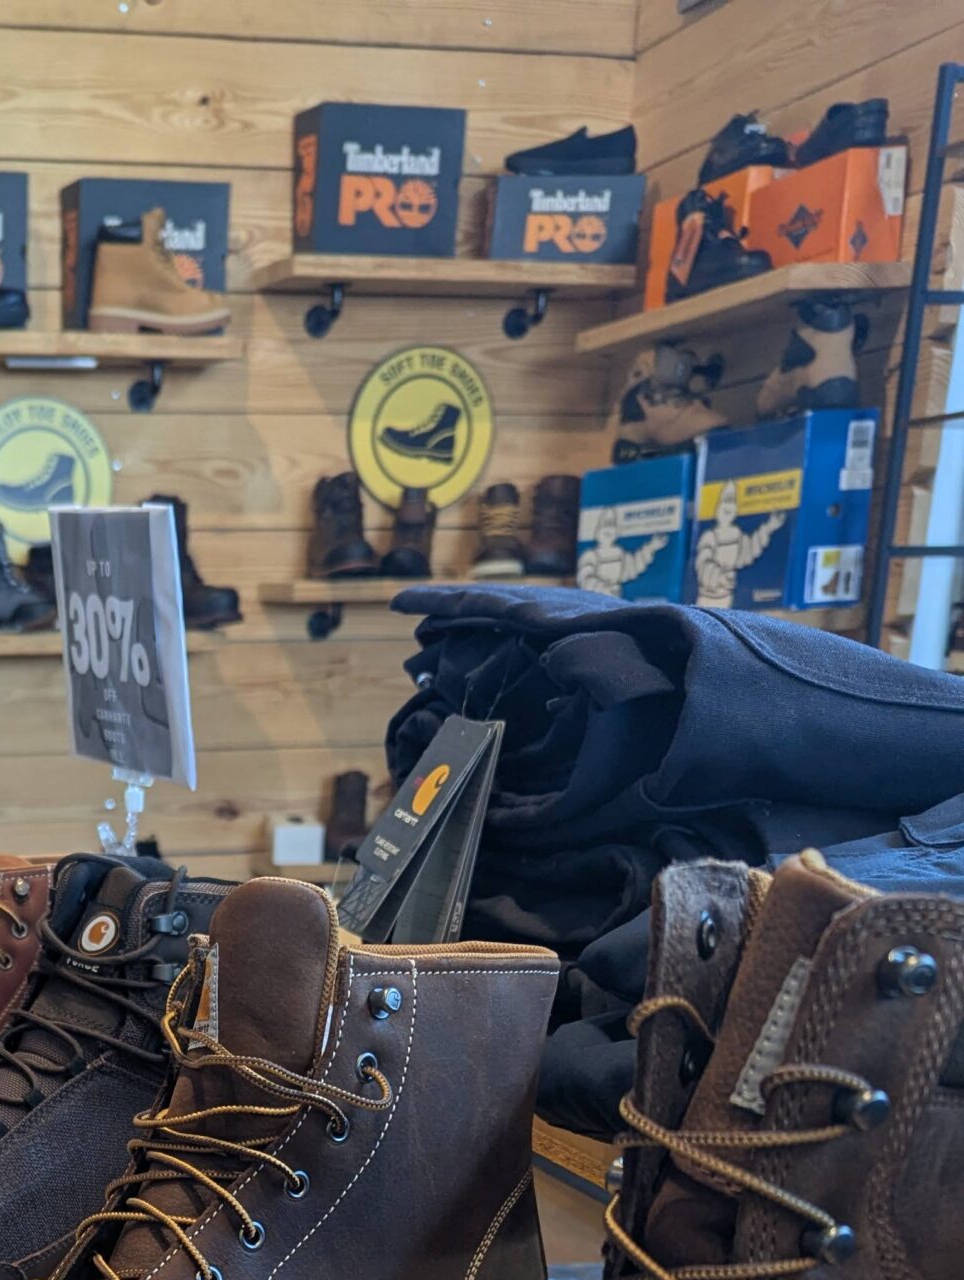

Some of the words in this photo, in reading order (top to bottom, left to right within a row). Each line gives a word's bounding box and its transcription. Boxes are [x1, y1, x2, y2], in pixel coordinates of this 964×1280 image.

[342, 141, 441, 175] Timberland
[528, 188, 612, 213] Timberland
[86, 559, 98, 577] UP
[99, 560, 112, 579] TO
[68, 591, 151, 688] 30%
